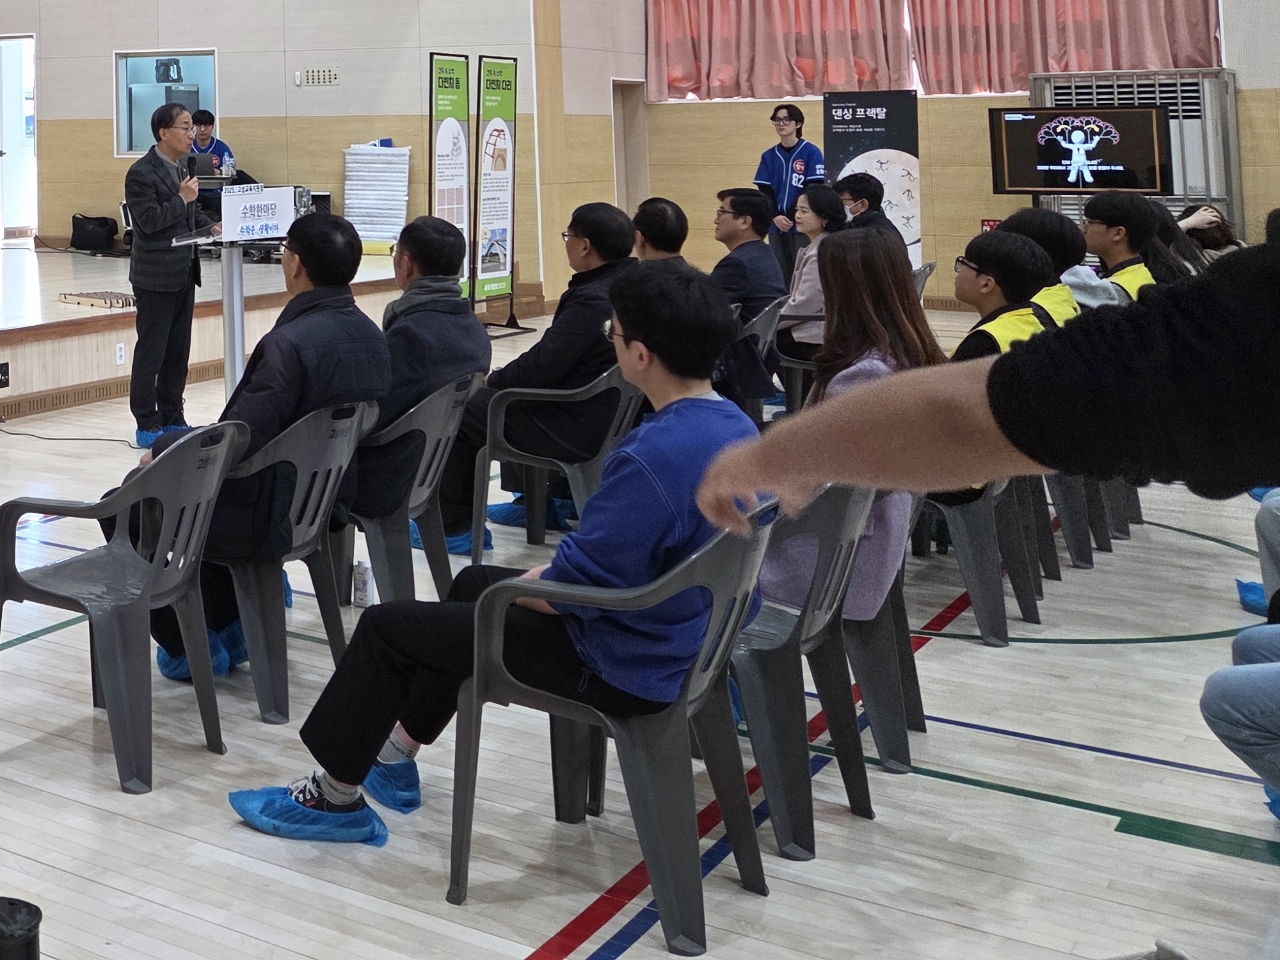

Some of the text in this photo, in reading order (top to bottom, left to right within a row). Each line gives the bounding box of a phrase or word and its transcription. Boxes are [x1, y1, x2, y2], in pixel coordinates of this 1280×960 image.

[832, 107, 887, 120] 댄싱 프랙탈
[791, 173, 805, 188] 82
[241, 202, 277, 219] 수학한마당
